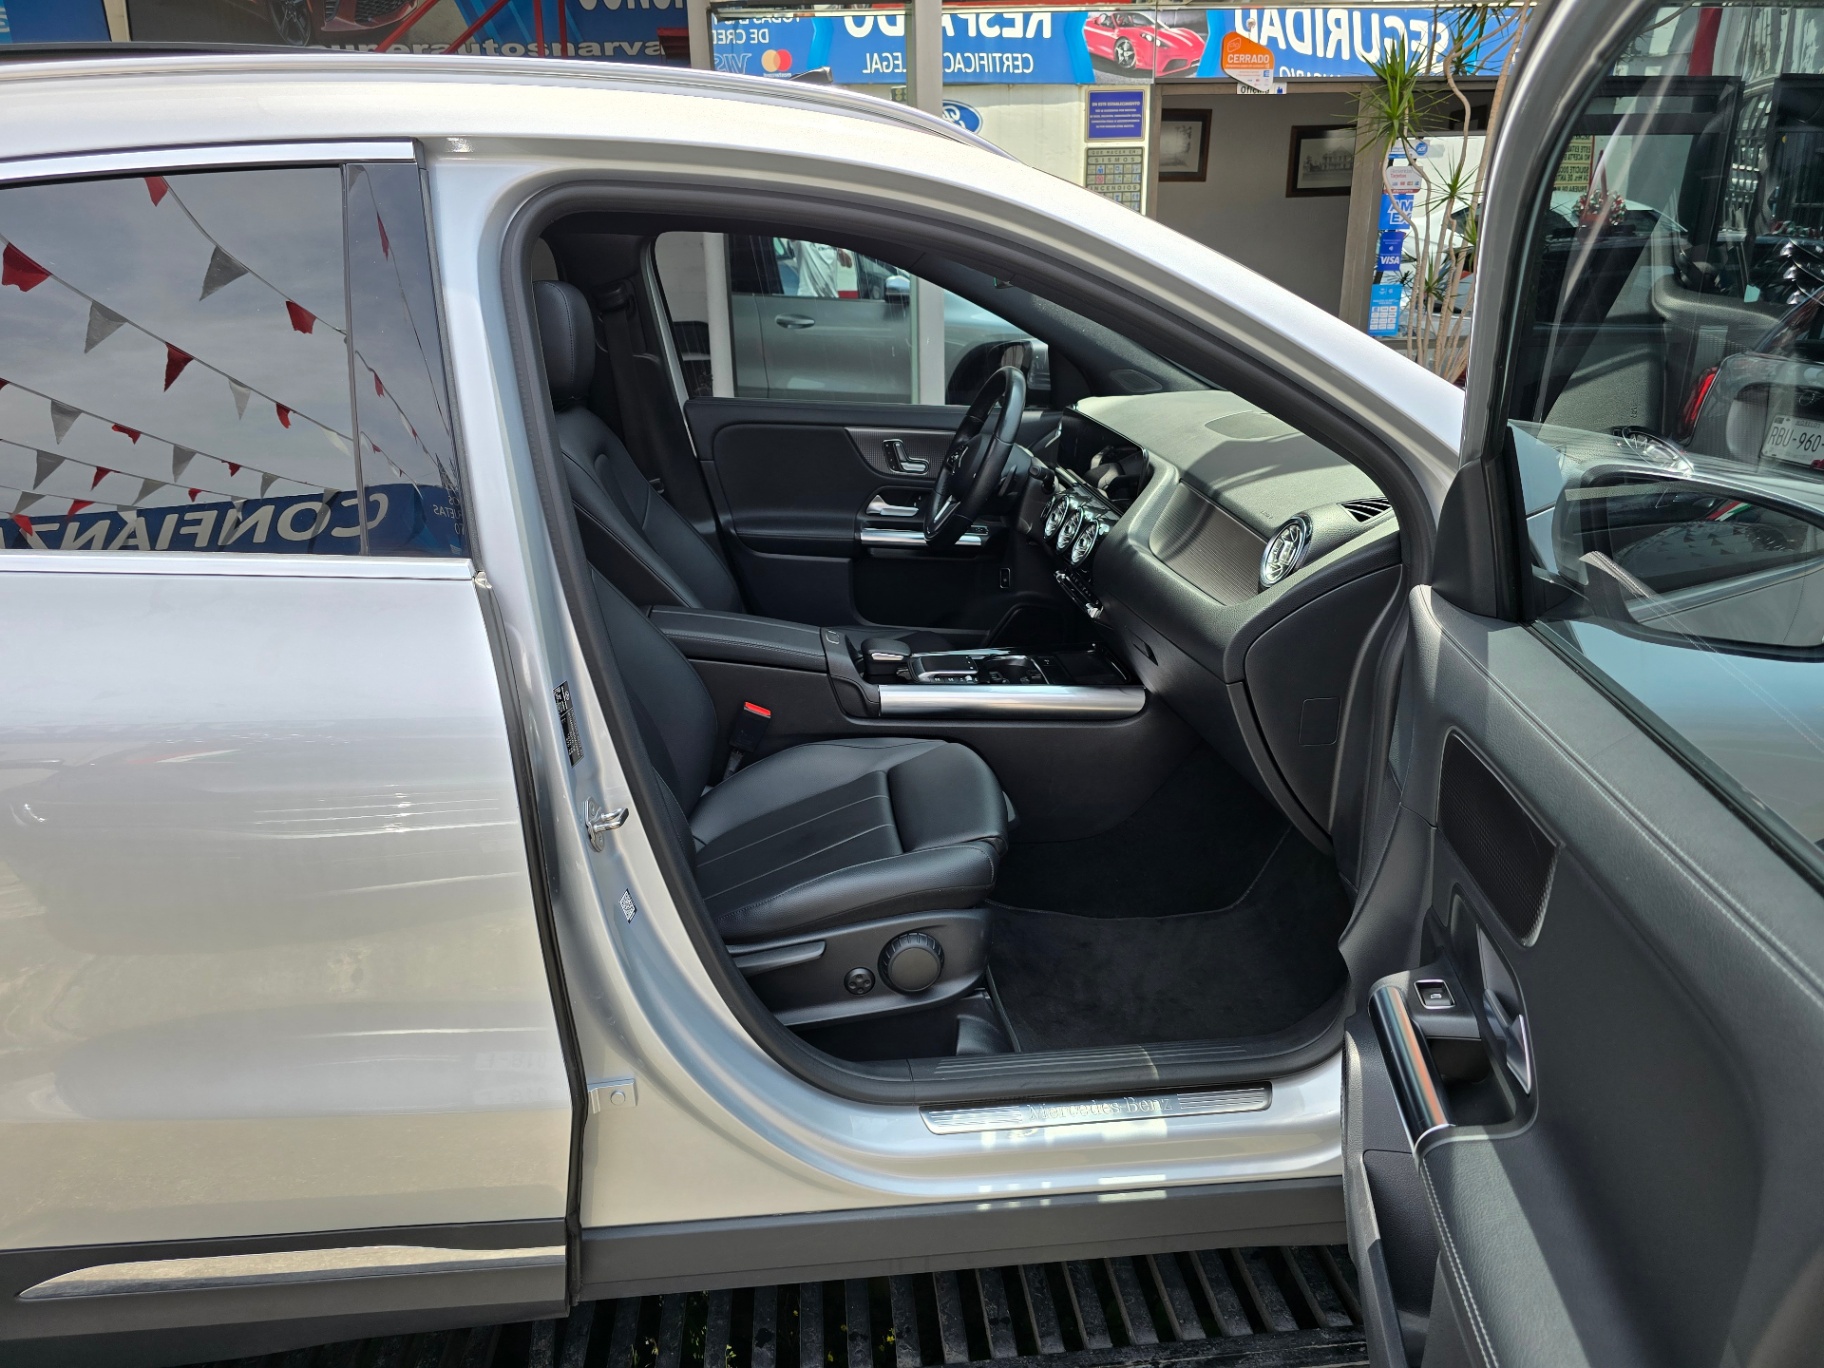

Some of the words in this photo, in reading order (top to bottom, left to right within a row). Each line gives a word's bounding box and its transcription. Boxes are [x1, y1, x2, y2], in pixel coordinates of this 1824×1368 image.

[1227, 54, 1270, 64] CERRADO
[1380, 256, 1400, 265] VISA
[1768, 427, 1824, 452] RBU-960-
